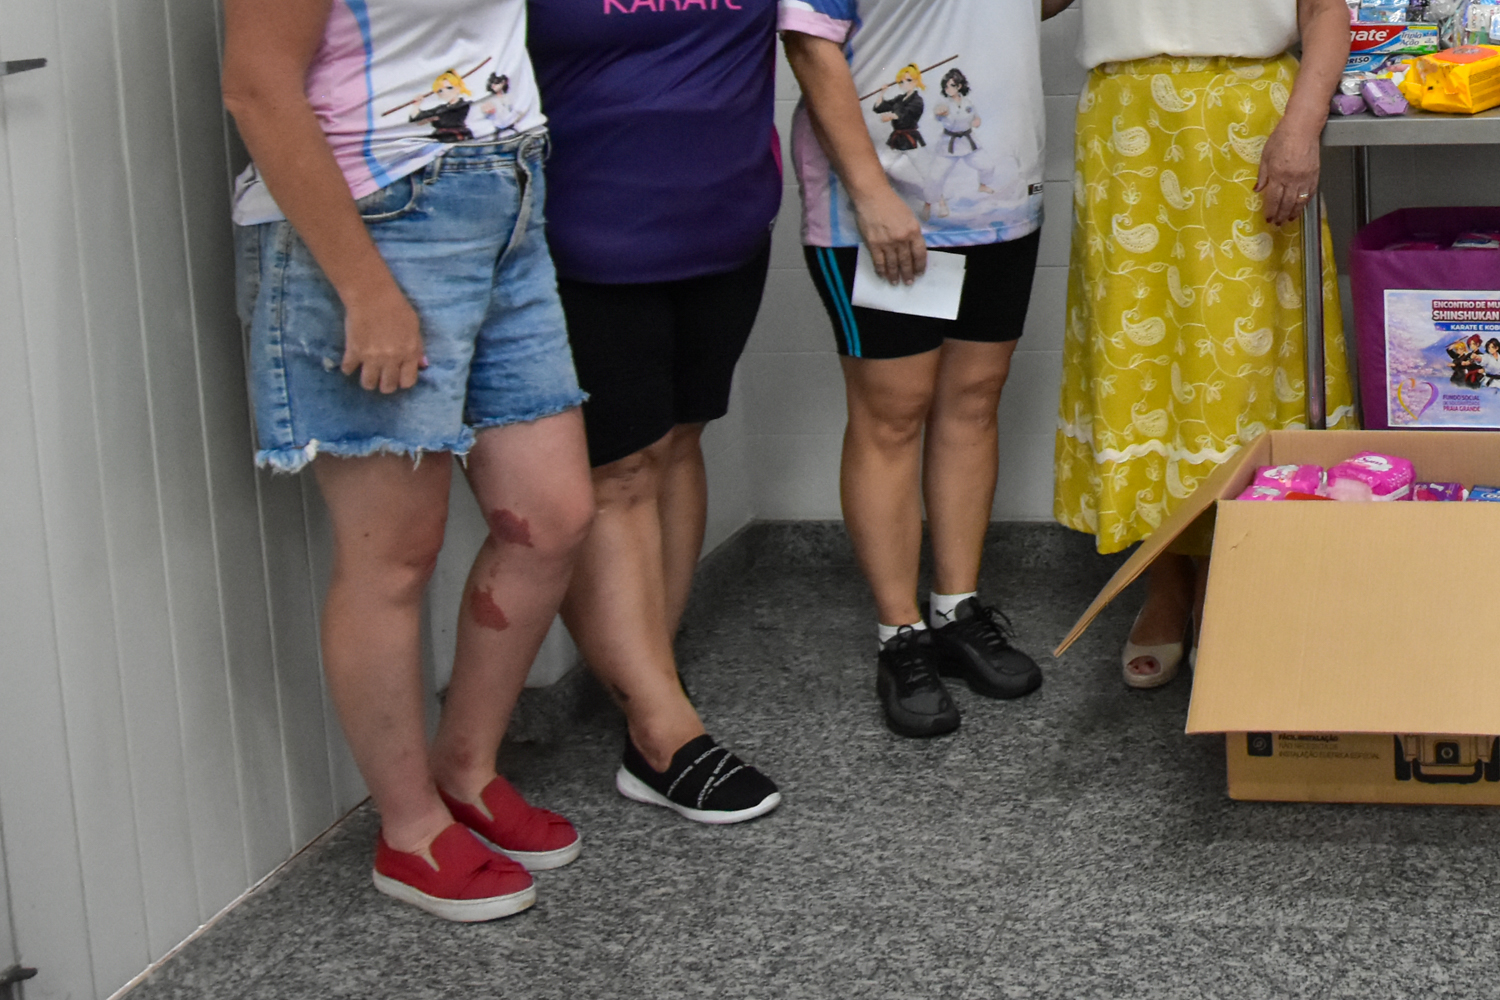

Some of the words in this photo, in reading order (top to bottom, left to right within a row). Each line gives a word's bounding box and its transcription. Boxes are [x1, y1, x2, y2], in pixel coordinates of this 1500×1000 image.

[1401, 32, 1422, 40] Tripla
[1400, 39, 1420, 47] Ação
[1433, 301, 1475, 309] ENCONTRO
[1476, 301, 1486, 309] DE
[1433, 310, 1500, 321] SHINSHUKAN
